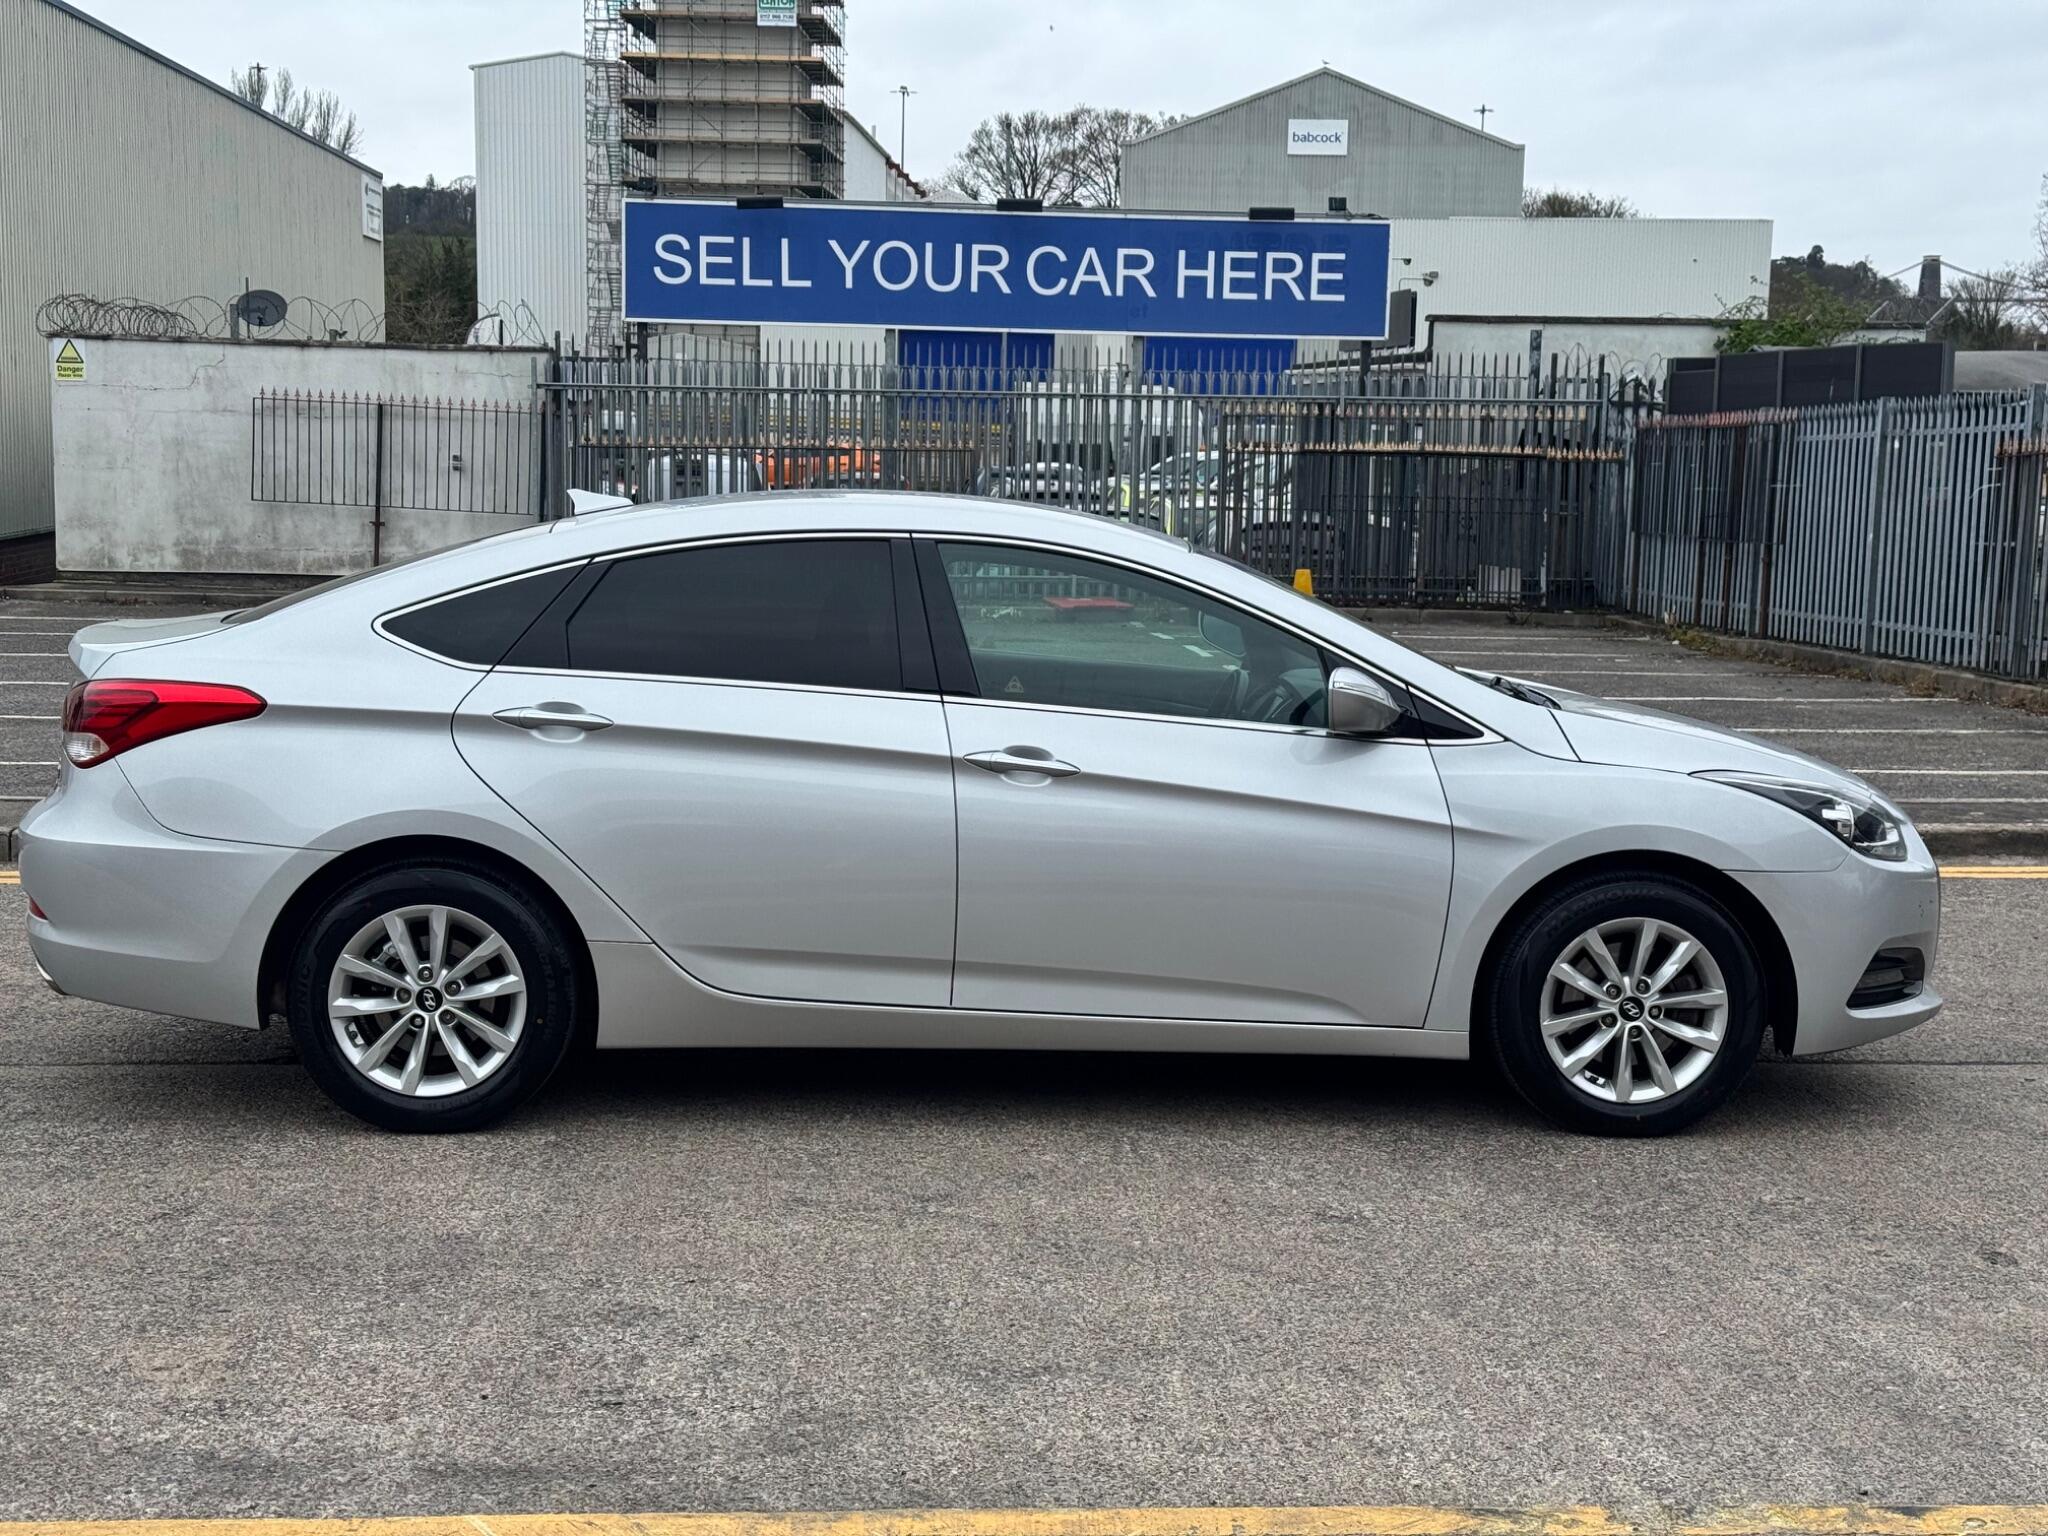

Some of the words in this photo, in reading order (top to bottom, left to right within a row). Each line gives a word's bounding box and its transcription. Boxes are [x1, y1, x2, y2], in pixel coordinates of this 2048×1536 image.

[1293, 131, 1342, 143] babcock
[653, 233, 812, 288] SELL
[827, 239, 1012, 294] YOUR
[1026, 245, 1157, 298] CAR
[1177, 249, 1346, 302] HERE
[57, 365, 84, 373] Danger
